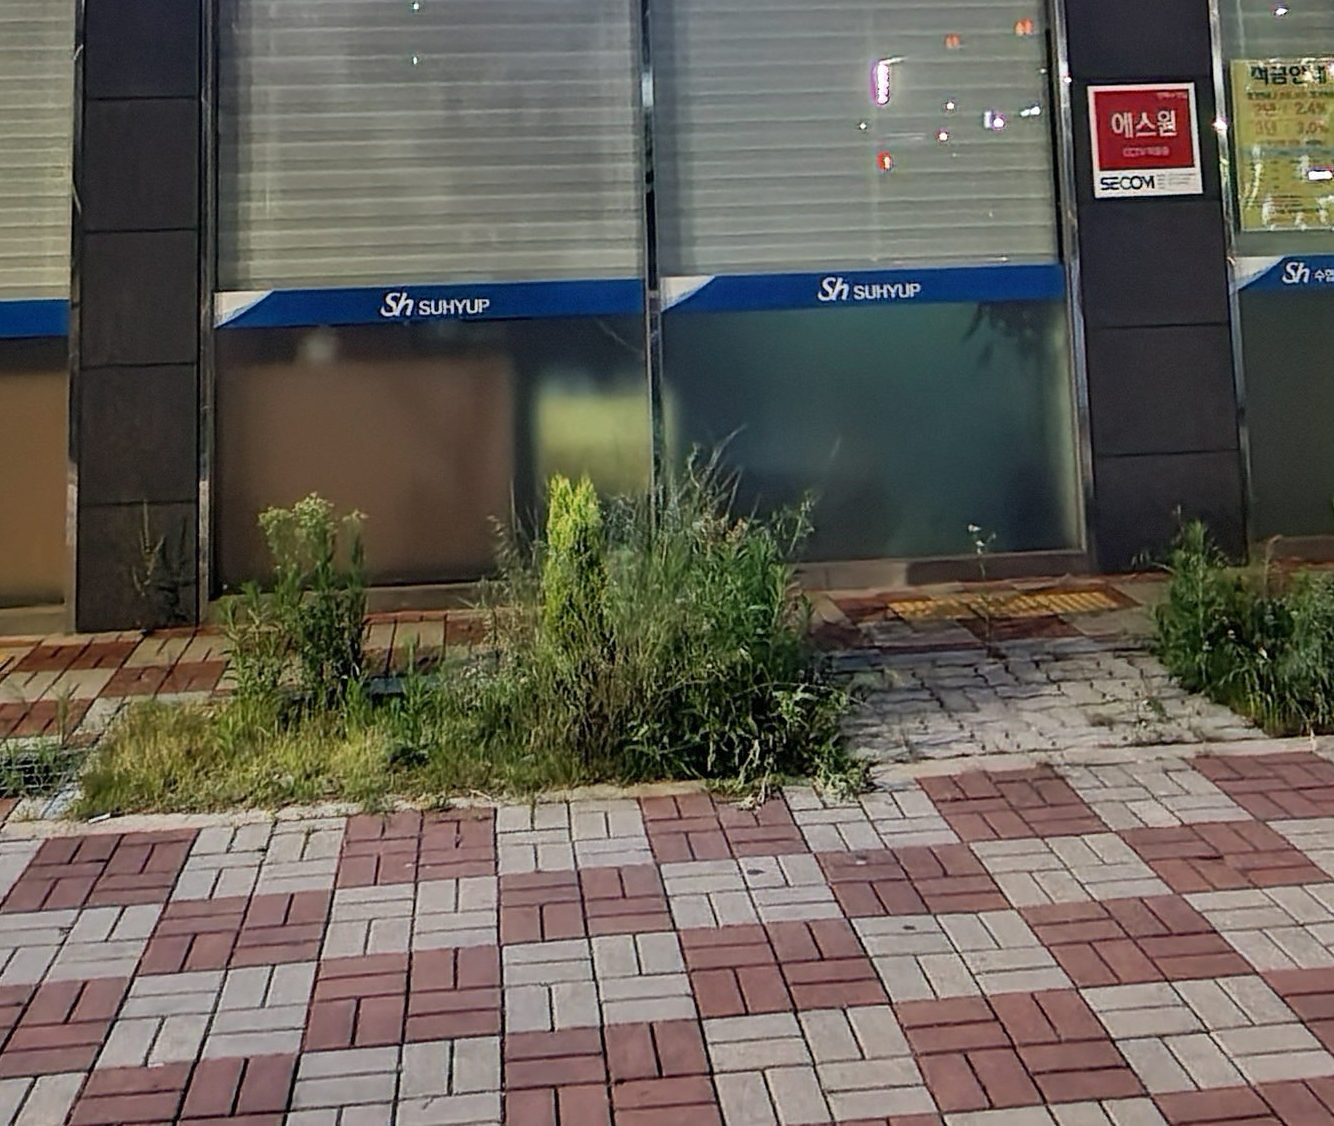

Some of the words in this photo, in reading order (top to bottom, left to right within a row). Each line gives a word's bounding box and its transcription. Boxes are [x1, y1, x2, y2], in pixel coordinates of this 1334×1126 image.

[1111, 109, 1178, 139] 에스원
[1100, 175, 1156, 191] SECOM
[1281, 261, 1310, 285] Sh
[817, 276, 850, 302] Sh
[853, 282, 922, 300] SUHYUP
[380, 291, 415, 317] Sh
[418, 298, 490, 316] SUHYUP
